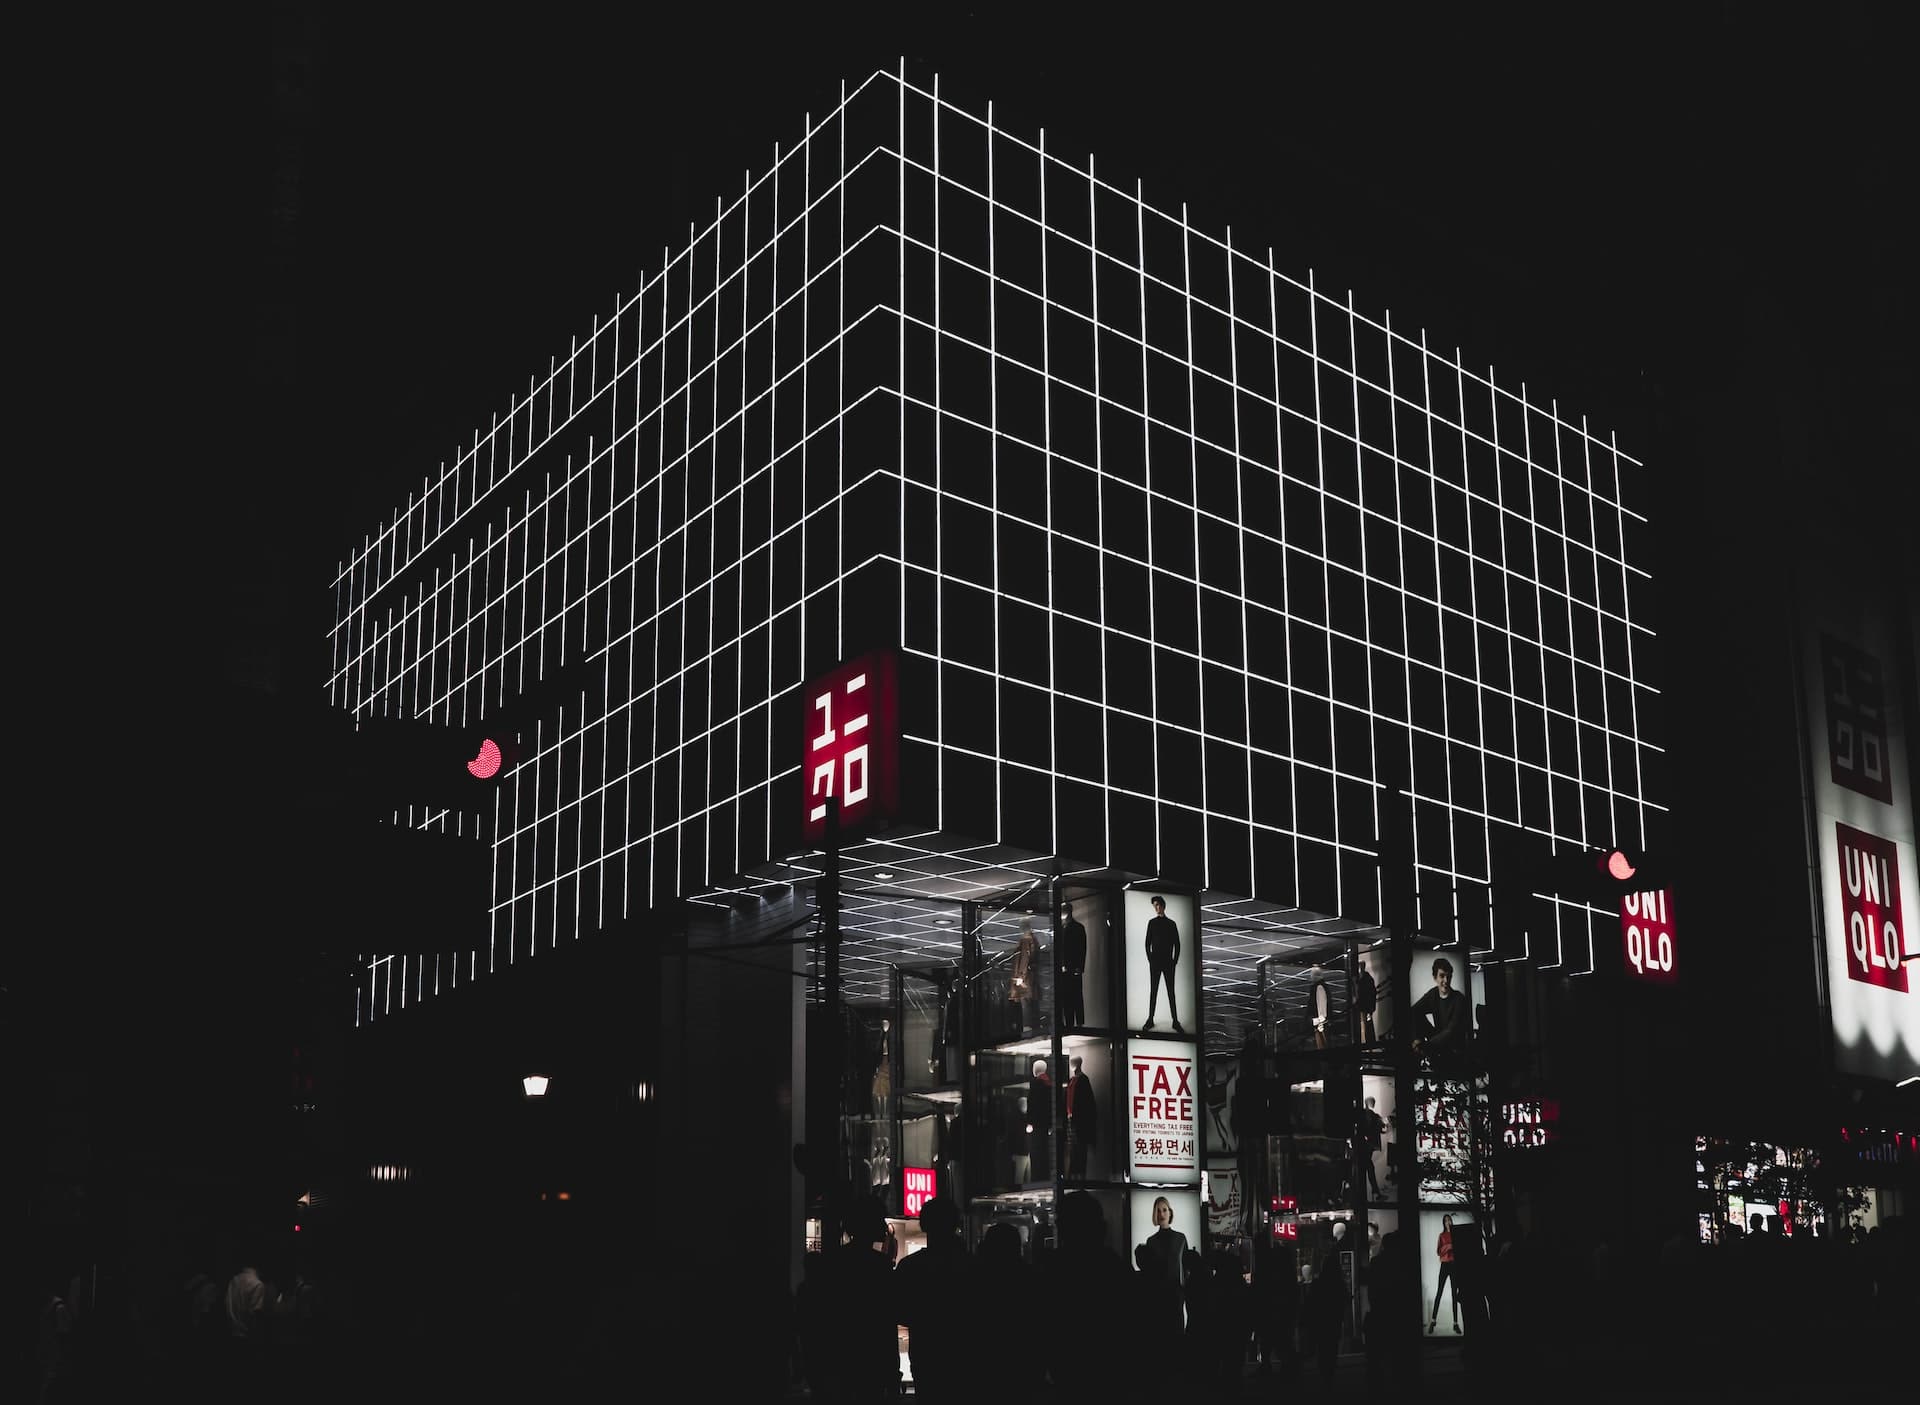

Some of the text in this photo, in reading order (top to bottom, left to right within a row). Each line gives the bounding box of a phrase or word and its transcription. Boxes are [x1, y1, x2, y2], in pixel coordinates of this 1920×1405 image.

[812, 673, 868, 752] ユニ
[810, 743, 869, 823] クロ
[1844, 845, 1890, 908] UNI
[1624, 889, 1667, 924] UNI
[1627, 924, 1672, 974] QLO
[1850, 910, 1899, 973] QLO
[1132, 1063, 1192, 1097] TAX
[1133, 1096, 1193, 1121] FREE
[1133, 1122, 1165, 1130] EVERYTHING
[1134, 1137, 1194, 1157] 免税 면세
[906, 1173, 932, 1192] UNI
